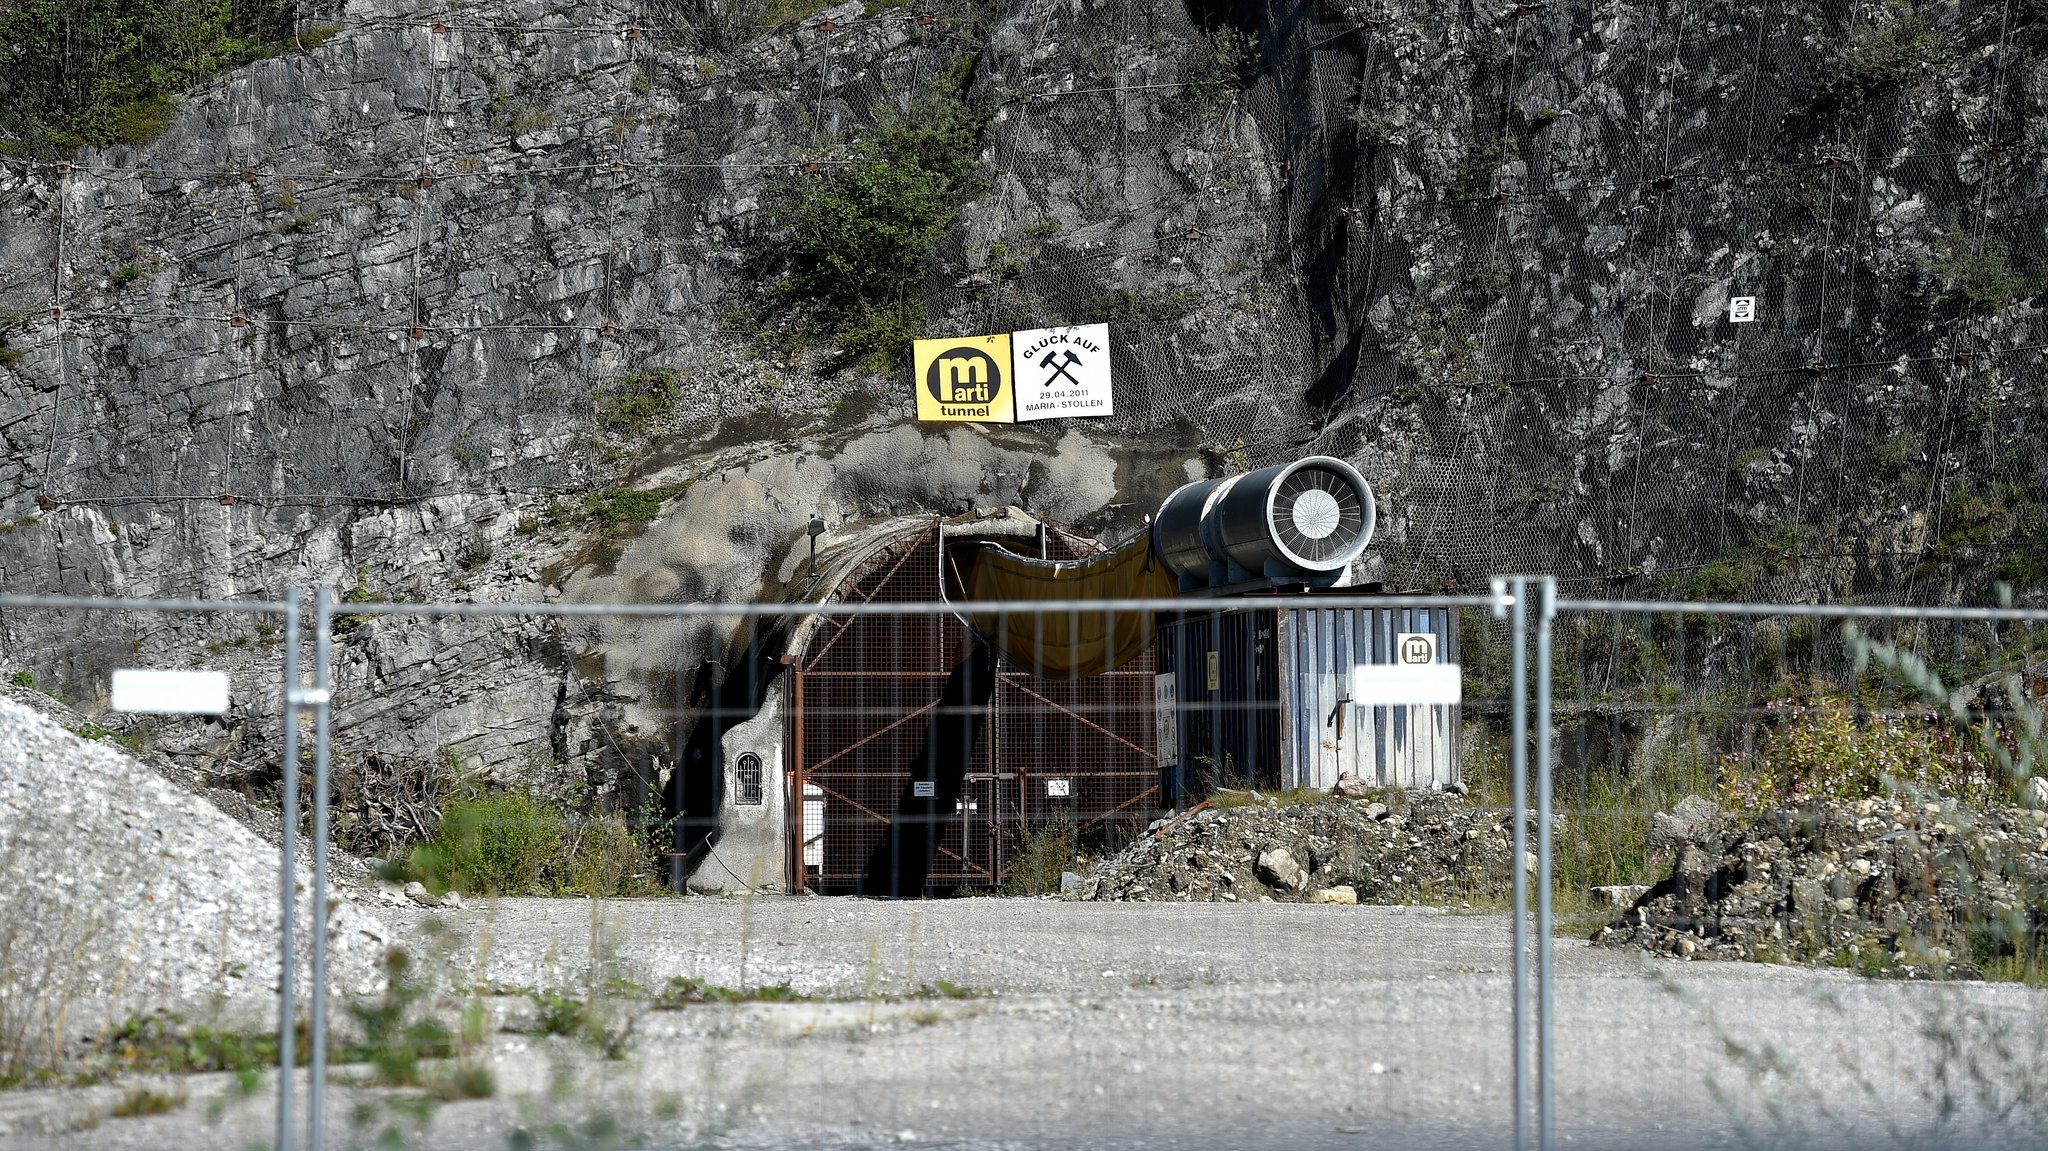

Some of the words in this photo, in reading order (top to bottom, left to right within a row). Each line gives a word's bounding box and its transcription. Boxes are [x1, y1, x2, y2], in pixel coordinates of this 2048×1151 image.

[1023, 335, 1069, 360] GLÜCK
[1073, 336, 1101, 354] AUF
[1039, 389, 1089, 399] 29.04.2011
[940, 405, 990, 417] tunnel
